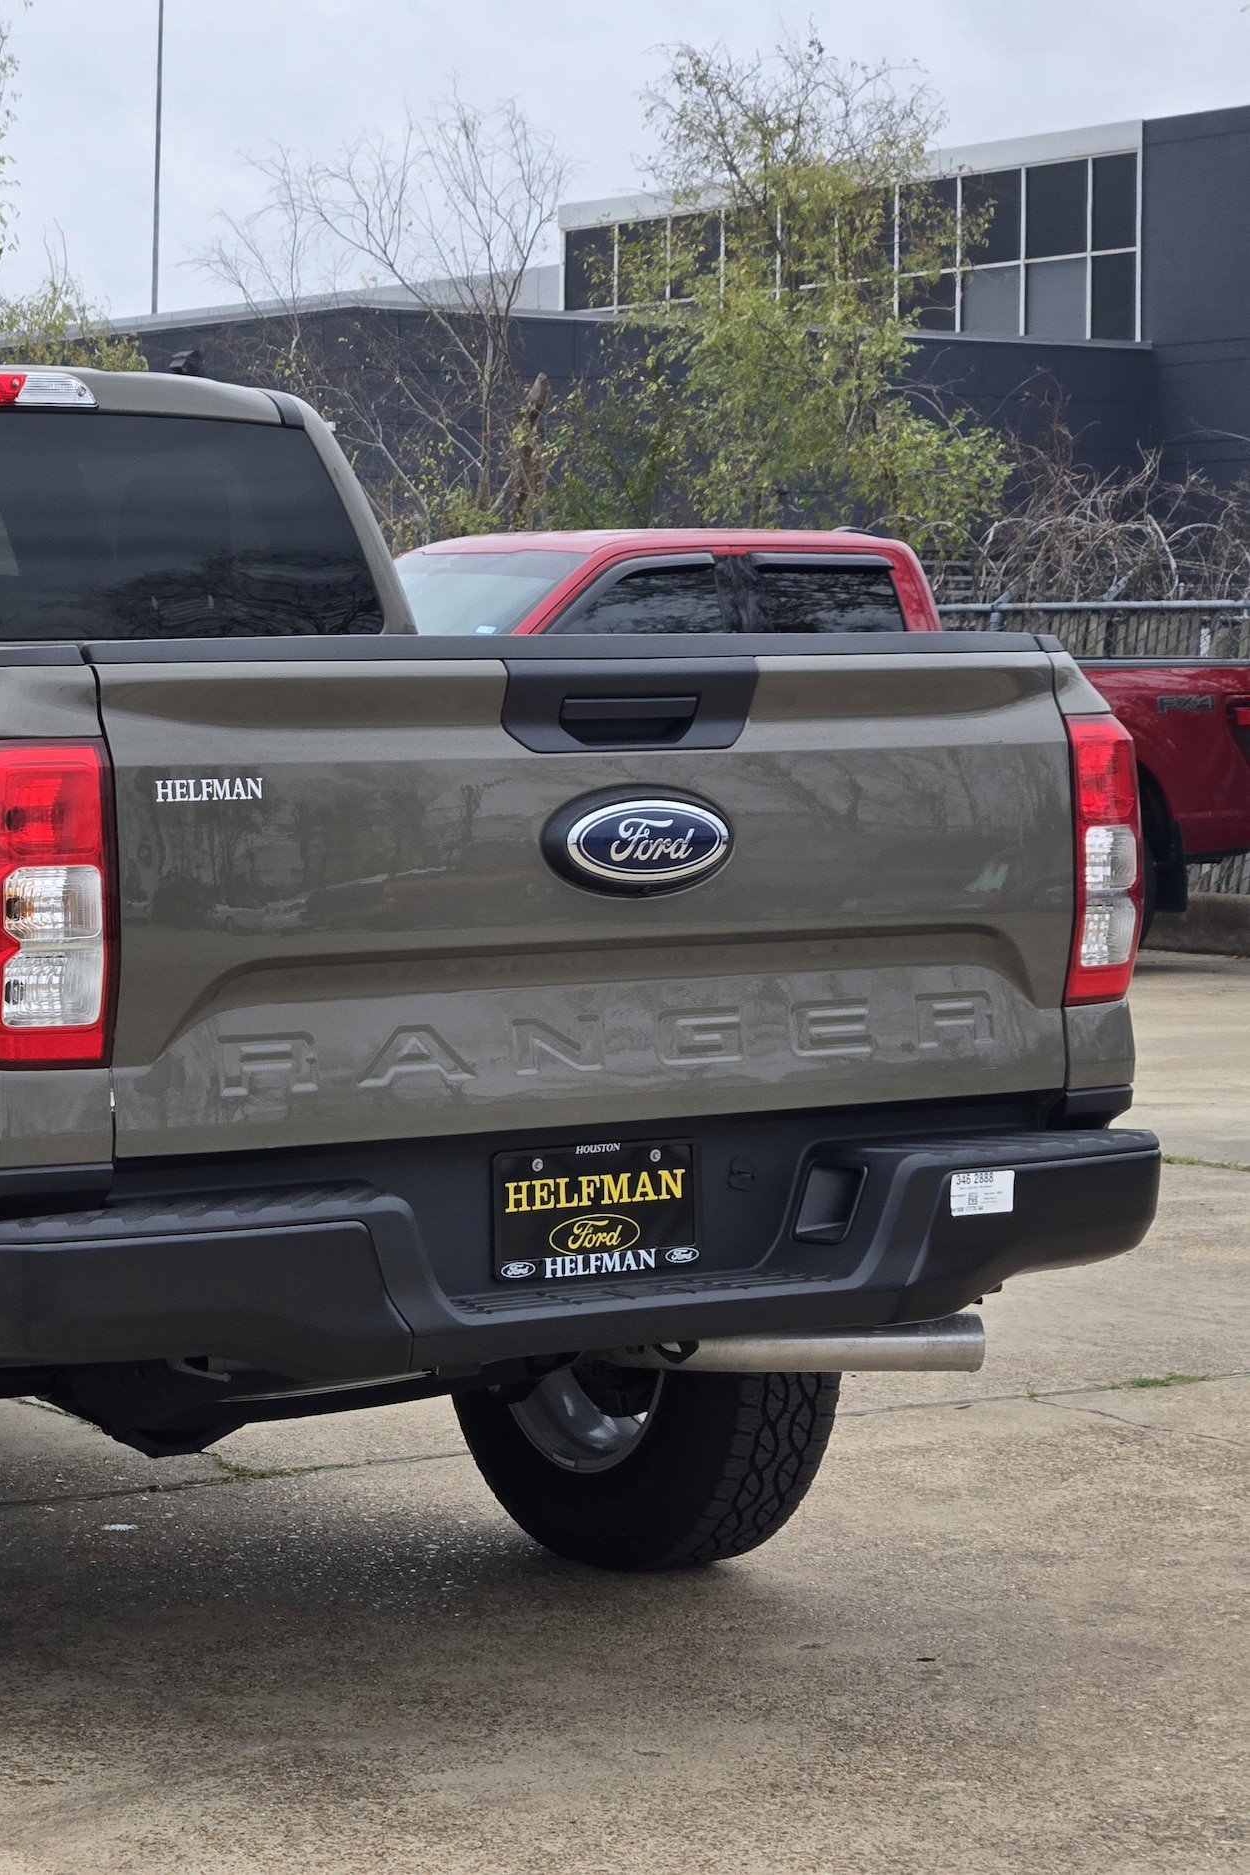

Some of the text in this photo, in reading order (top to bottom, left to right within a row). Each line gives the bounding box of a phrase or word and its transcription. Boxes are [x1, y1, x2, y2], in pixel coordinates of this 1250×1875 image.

[1157, 694, 1214, 714] FX4
[155, 777, 263, 802] HELFMAN
[610, 817, 695, 862] Ford
[217, 990, 994, 1097] RANGER
[575, 1142, 621, 1155] HOUSTON
[505, 1168, 686, 1213] HELFMAN
[567, 1219, 622, 1250] Ford
[544, 1248, 656, 1278] HELFMAN
